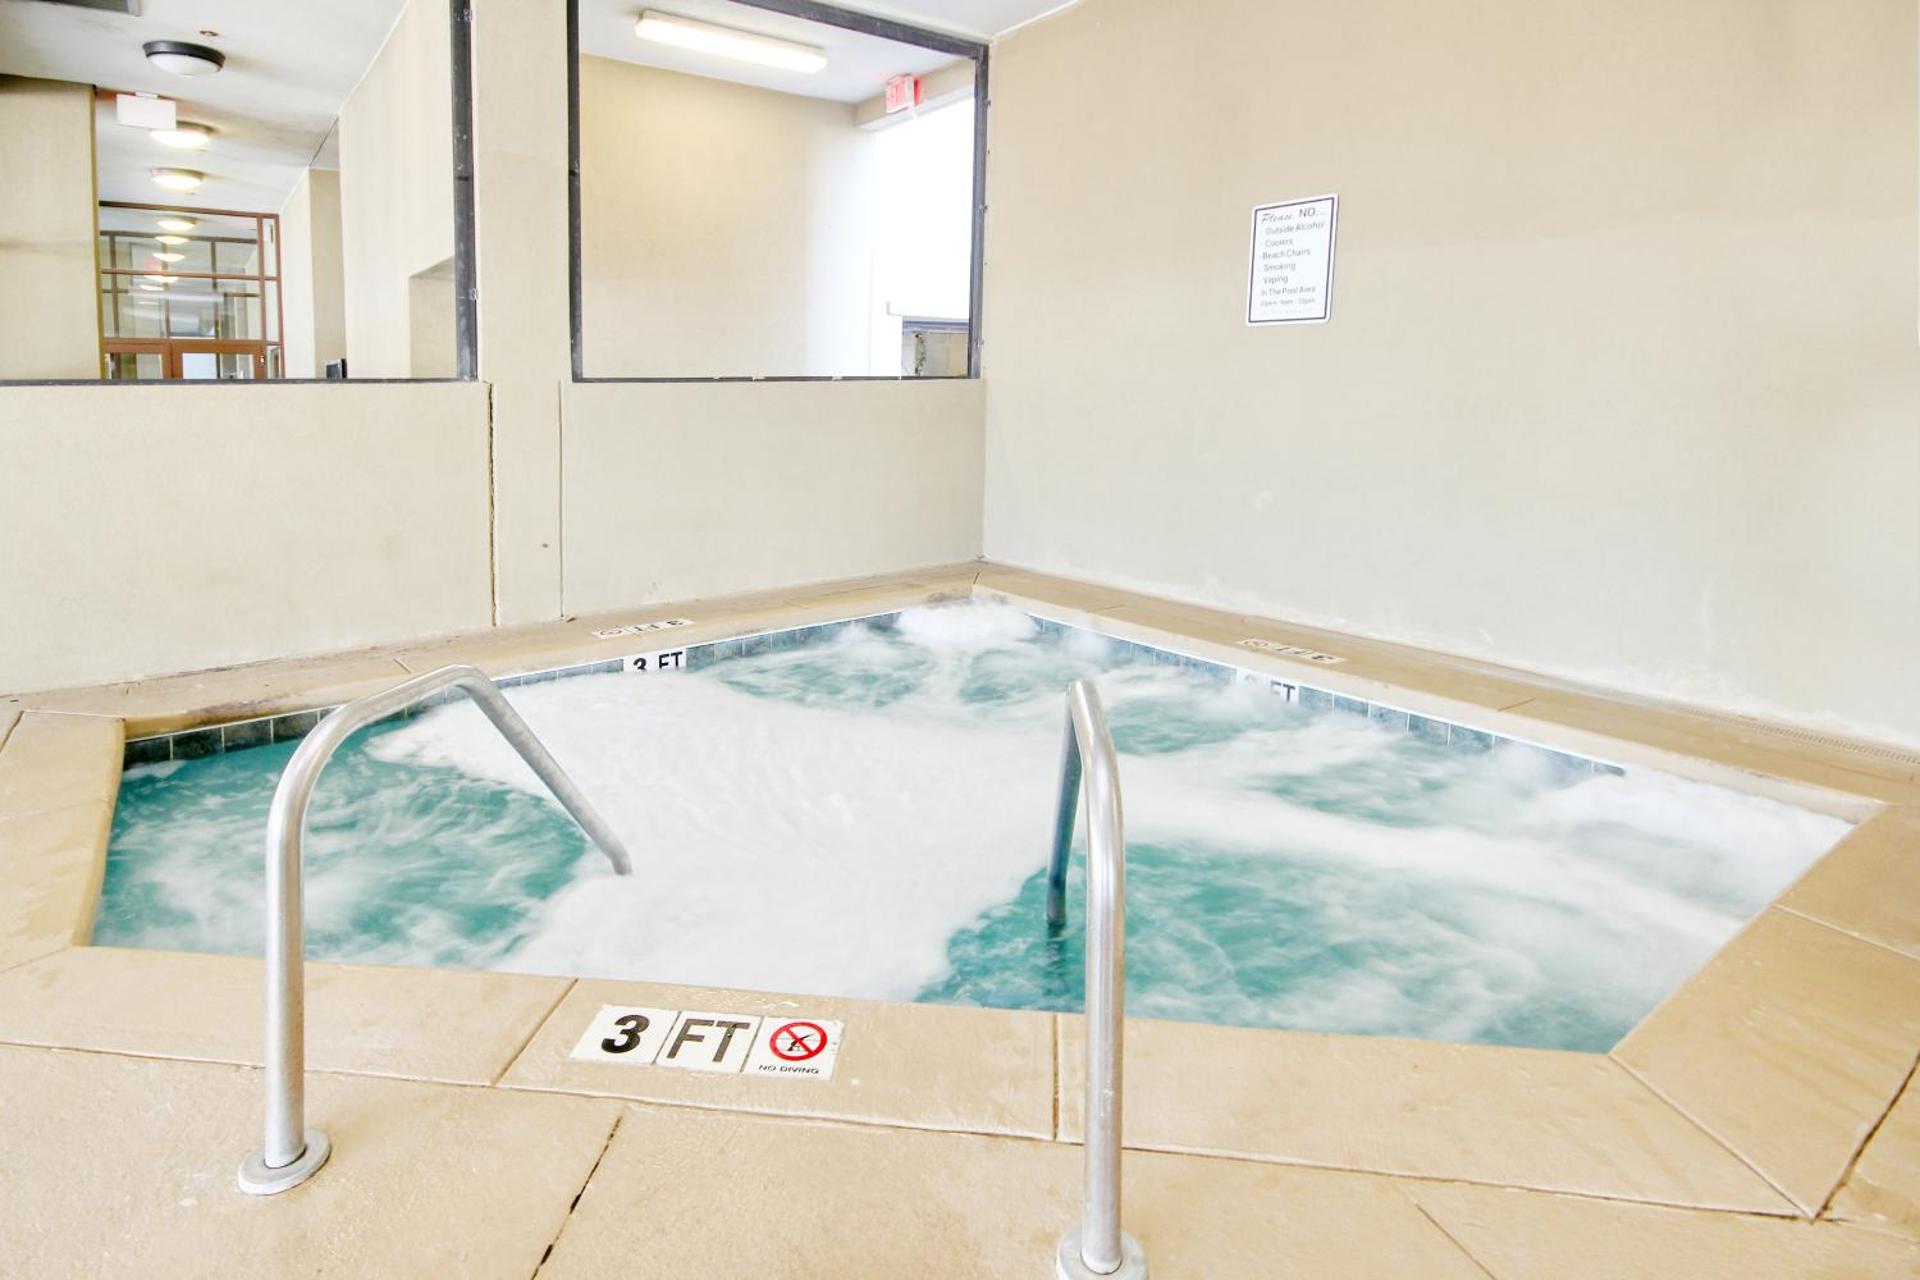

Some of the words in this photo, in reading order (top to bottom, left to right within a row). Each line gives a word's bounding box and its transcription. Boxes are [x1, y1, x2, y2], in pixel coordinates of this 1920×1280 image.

[1265, 225, 1295, 236] Outside
[1296, 220, 1326, 231] Alcohol
[1264, 238, 1293, 248] Coolers
[1262, 251, 1286, 260] Beach
[1286, 248, 1312, 258] Chairs
[1263, 262, 1296, 272] Smoking
[1262, 275, 1289, 285] Vaping
[658, 651, 684, 671] FT
[601, 1014, 651, 1054] 3
[666, 1018, 751, 1063] FT
[758, 1064, 777, 1072] NO
[780, 1065, 820, 1075] DIVING
